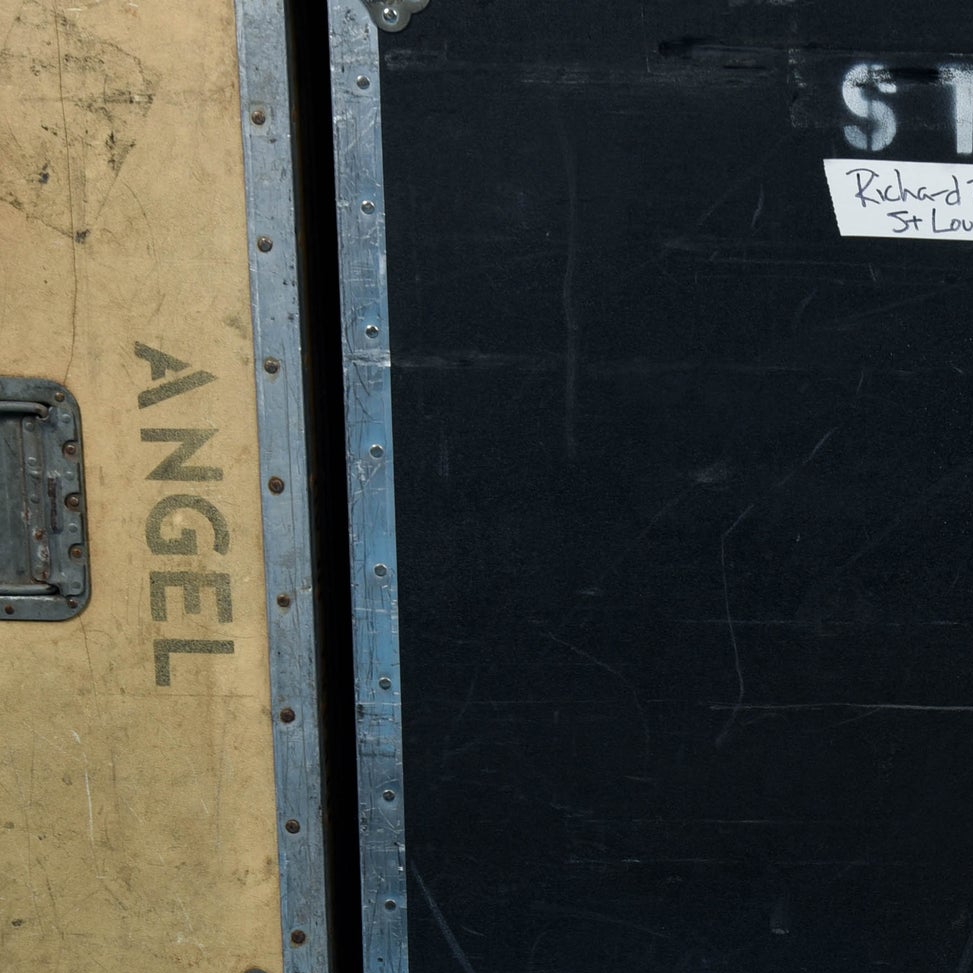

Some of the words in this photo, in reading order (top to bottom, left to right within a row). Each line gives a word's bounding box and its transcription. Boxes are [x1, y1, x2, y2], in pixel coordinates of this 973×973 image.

[846, 168, 962, 208] Richard
[886, 210, 923, 233] St
[133, 340, 235, 687] ANGEL
